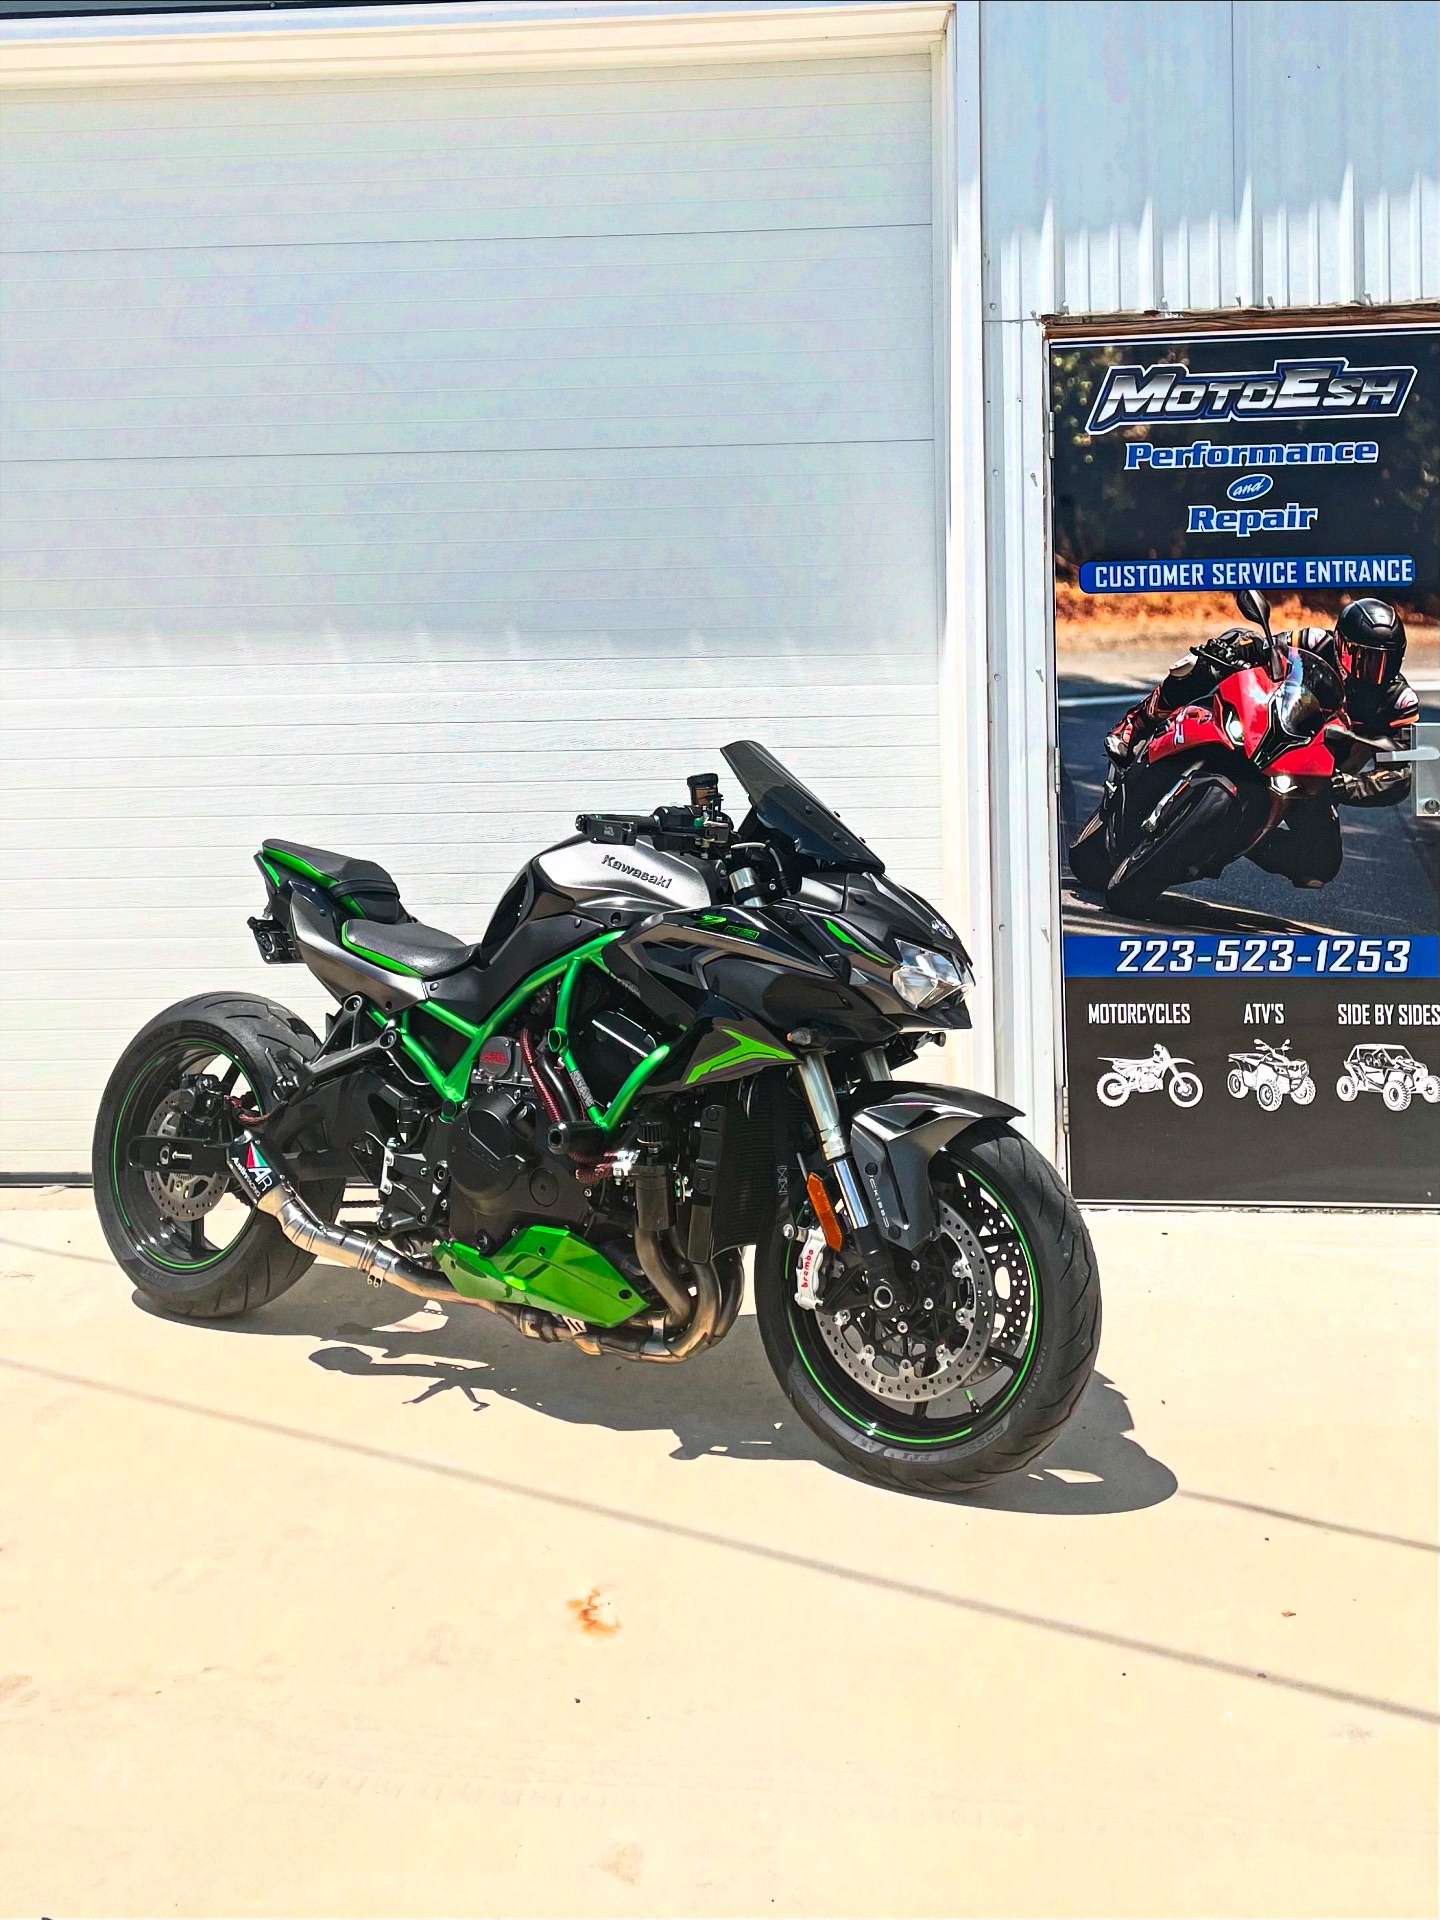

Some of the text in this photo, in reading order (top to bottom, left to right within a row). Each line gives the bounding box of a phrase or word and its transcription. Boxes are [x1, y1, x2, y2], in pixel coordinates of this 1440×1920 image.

[1125, 440, 1378, 470] Performance
[1232, 477, 1265, 496] and
[1186, 503, 1318, 538] Repair
[1095, 558, 1414, 589] CUSTOMER SERVICE ENTRANCE
[601, 854, 673, 889] Kawasaki
[1116, 938, 1411, 974] 223-523-1253
[1088, 1003, 1191, 1025] MOTORCYCLES
[1243, 1003, 1285, 1025] ATV'S
[1337, 1003, 1440, 1026] SIDE BY SIDES
[247, 1167, 273, 1192] AR
[801, 1249, 814, 1288] brembo
